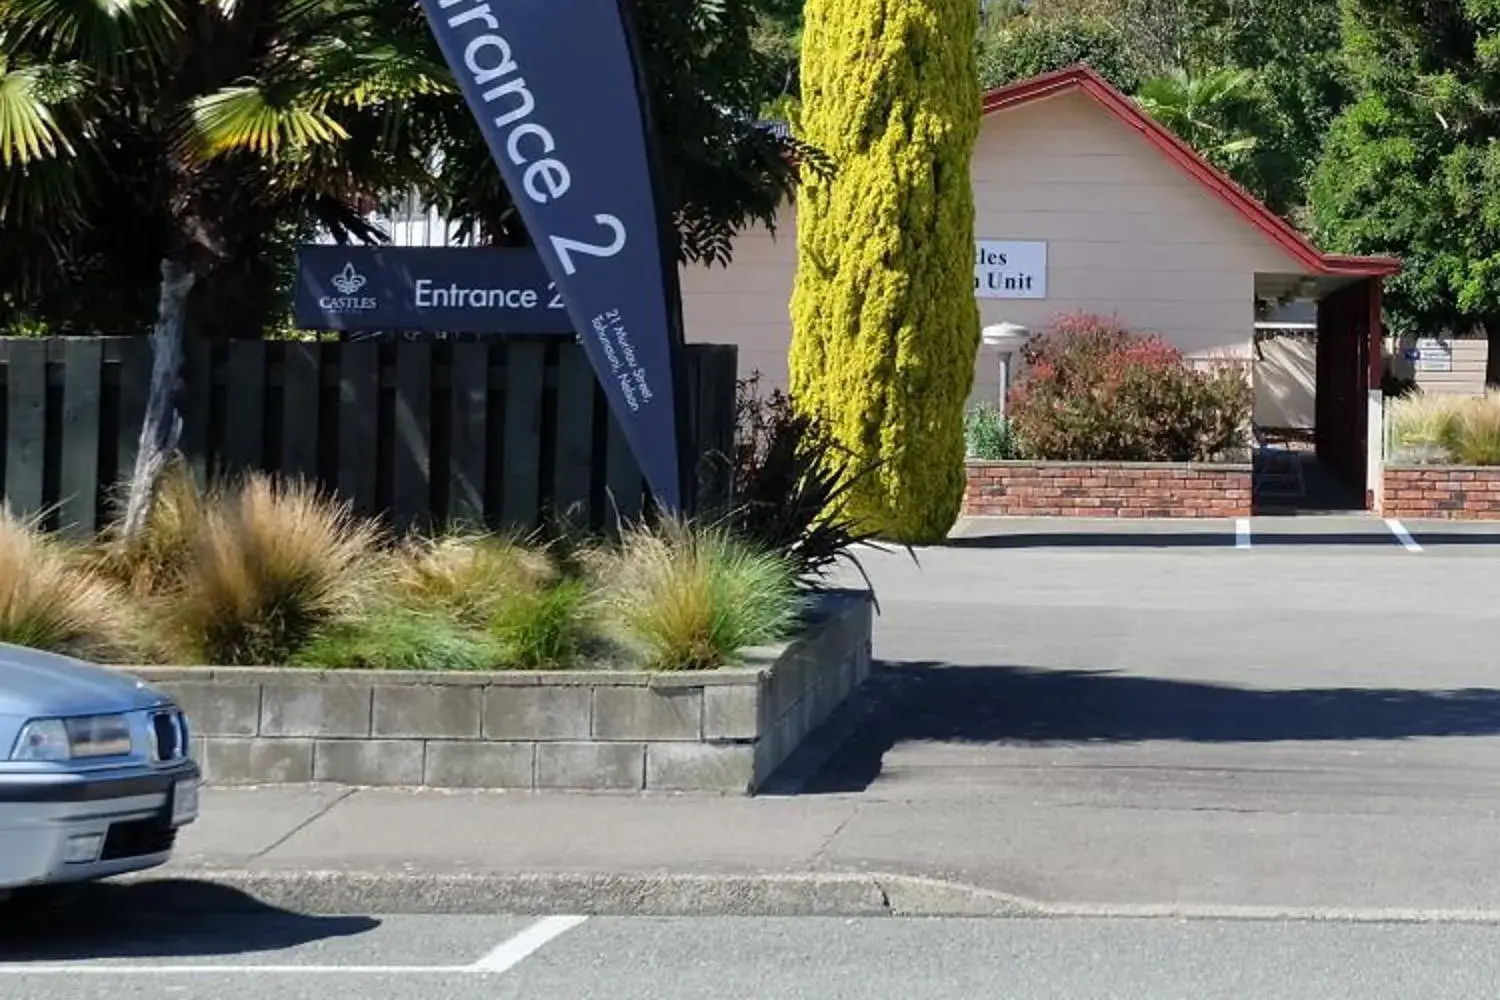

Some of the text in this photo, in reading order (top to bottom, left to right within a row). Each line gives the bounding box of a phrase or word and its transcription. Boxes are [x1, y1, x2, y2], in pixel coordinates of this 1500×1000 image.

[549, 213, 627, 276] 2
[988, 271, 1032, 289] Unit
[415, 279, 538, 308] Entrance
[319, 296, 376, 310] CASTLES
[605, 308, 621, 325] 21
